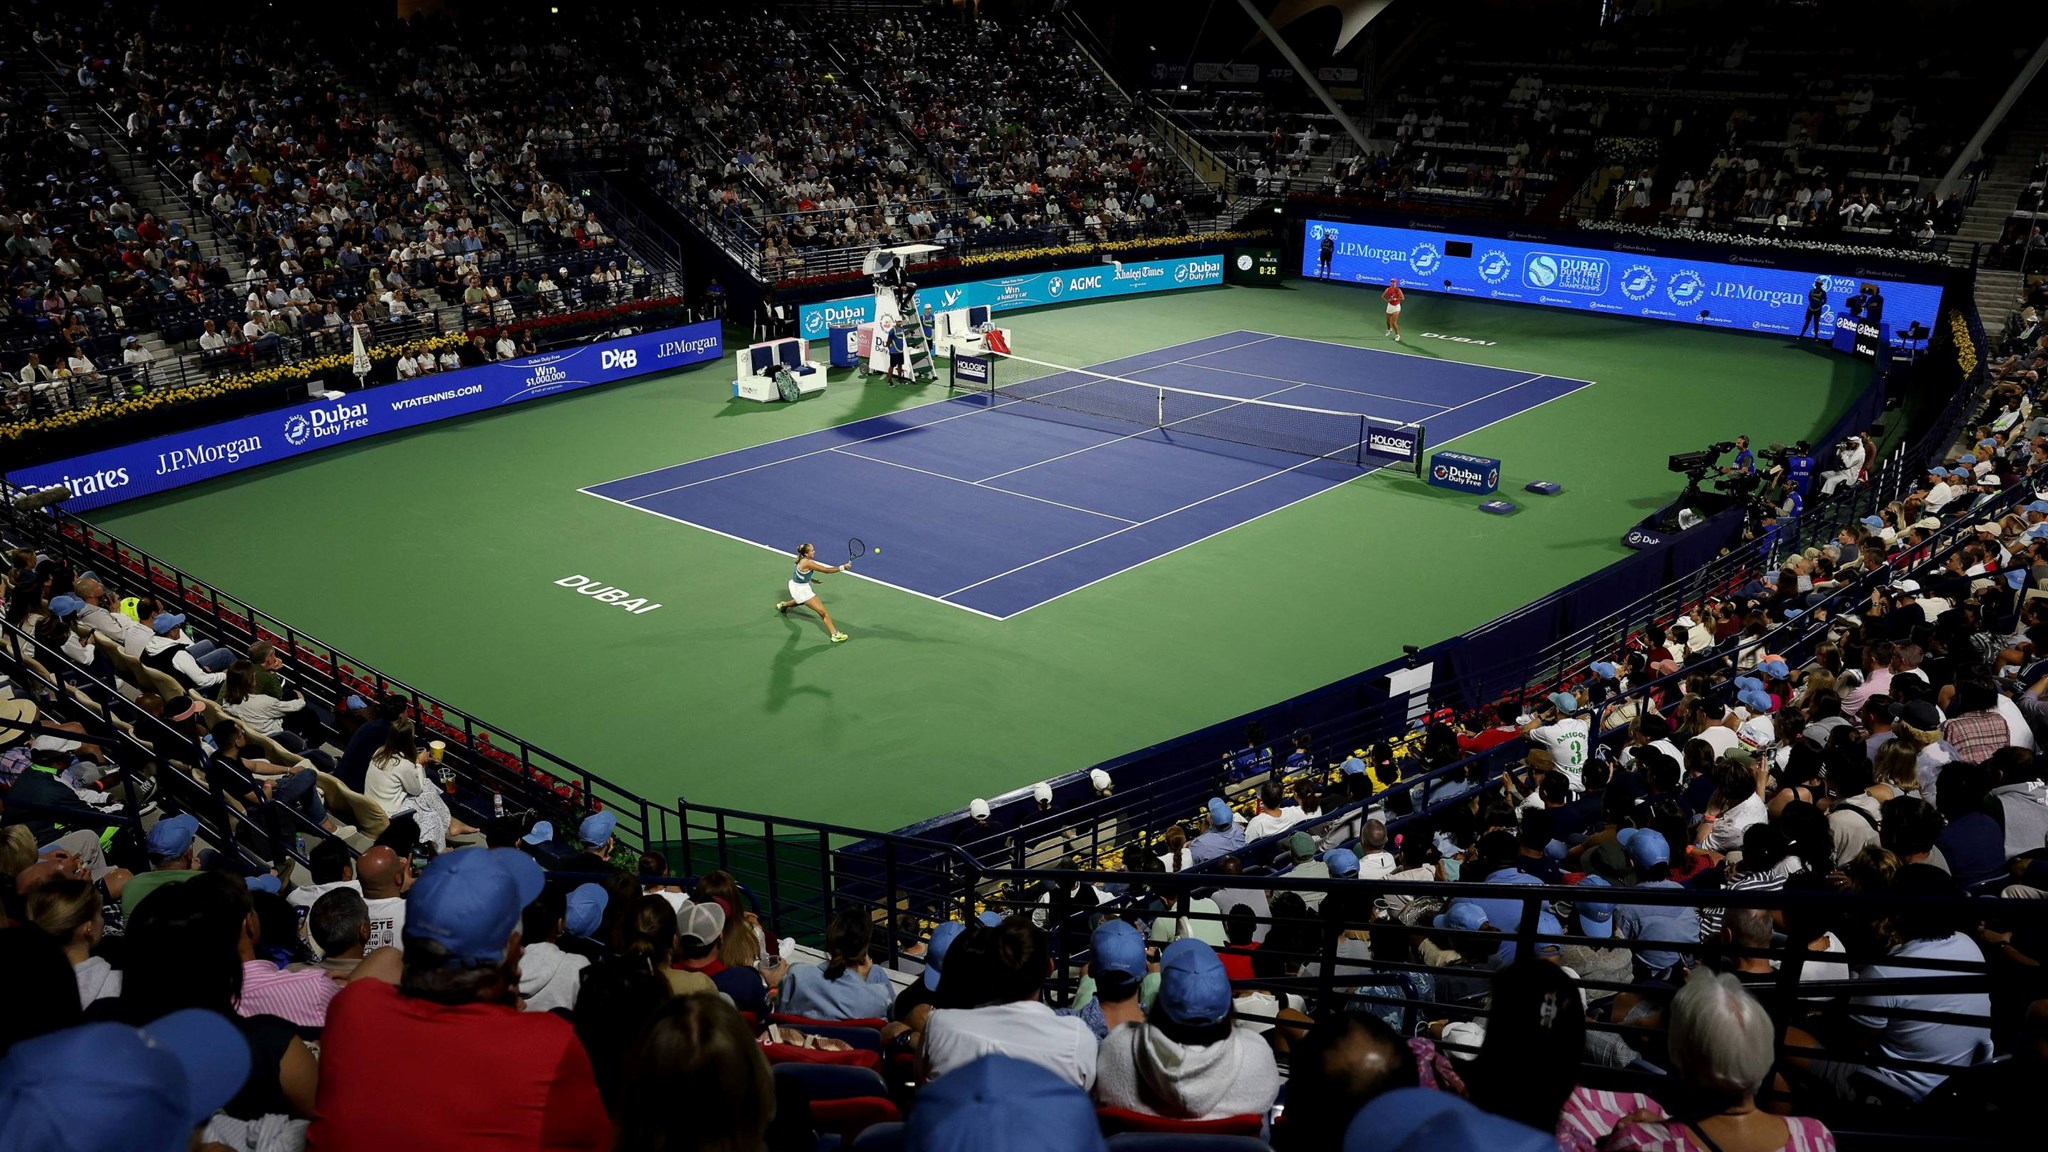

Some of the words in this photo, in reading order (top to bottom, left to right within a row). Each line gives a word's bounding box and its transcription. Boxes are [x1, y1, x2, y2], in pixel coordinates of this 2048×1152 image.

[1324, 227, 1339, 235] WTA
[1337, 242, 1407, 264] J.P.Morgan
[1141, 266, 1164, 278] Times
[1189, 261, 1220, 273] Dubai
[1259, 266, 1277, 275] 0:25
[1560, 259, 1604, 273] DUBAI
[1560, 268, 1582, 276] DUTY
[1069, 275, 1102, 291] AGMC
[1189, 273, 1204, 281] Duty
[1205, 271, 1220, 279] Free
[1560, 274, 1601, 286] TENNIS
[1834, 278, 1855, 287] WTA
[1004, 286, 1020, 294] Win
[1710, 281, 1804, 308] J.P.Morgan
[1833, 286, 1853, 294] 1000
[824, 305, 865, 321] Dubai
[1420, 332, 1497, 346] DUBAI
[657, 336, 717, 359] J.P.Morgan
[1856, 343, 1867, 354] 142
[535, 365, 557, 377] Win
[957, 360, 986, 373] HOLOGIC
[526, 371, 566, 387] $1,000,000
[391, 384, 483, 411] WTATENNIS.COM
[309, 403, 368, 427] Dubai
[313, 423, 341, 438] Duty
[343, 417, 369, 431] Free
[1370, 433, 1412, 449] HOLOGIC
[156, 435, 263, 475] J.P.Morgan
[1449, 465, 1482, 481] Dubai
[1448, 474, 1465, 485] Duty
[1465, 478, 1482, 487] Free
[12, 467, 129, 513] irates
[553, 574, 663, 615] DUBAI
[1570, 740, 1582, 765] 3
[371, 920, 393, 930] STE
